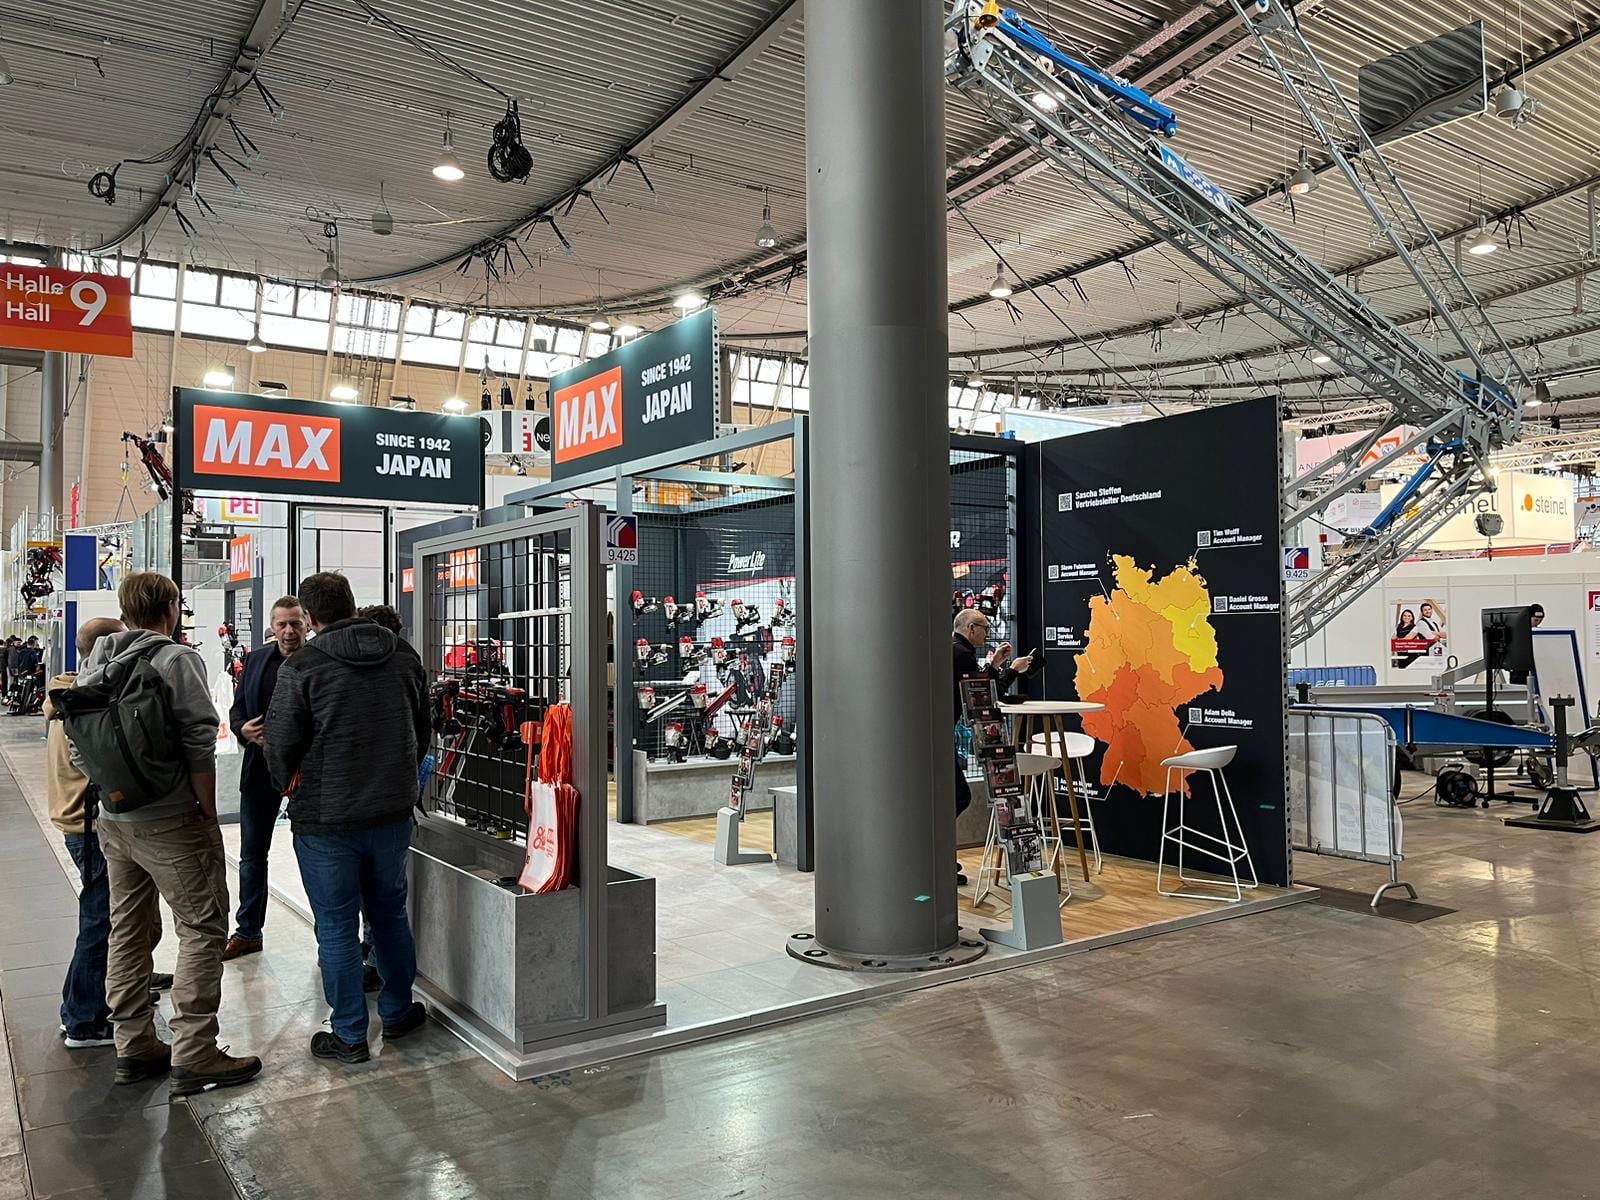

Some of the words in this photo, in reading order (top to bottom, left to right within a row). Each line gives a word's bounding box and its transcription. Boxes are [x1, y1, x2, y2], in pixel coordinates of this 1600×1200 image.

[6, 272, 64, 295] Halle
[70, 280, 107, 326] 9
[6, 301, 51, 322] Hall
[640, 365, 666, 387] SINCE
[668, 353, 692, 376] 1942
[641, 380, 693, 425] JAPAN
[558, 381, 619, 451] MAX
[202, 418, 333, 471] MAX
[375, 432, 416, 448] SINCE
[419, 437, 451, 451] 1942
[375, 453, 452, 479] JAPAN
[1075, 490, 1097, 499] Sascha
[1075, 497, 1119, 509] Vertriebsleiter
[1120, 489, 1161, 503] Deutschland
[1535, 494, 1568, 516] steinel
[1213, 536, 1236, 544] Account
[1237, 534, 1263, 543] Manager
[231, 541, 250, 575] MAX
[608, 549, 636, 562] 9.425
[1285, 570, 1309, 579] 9.425
[1229, 595, 1247, 603] Daniel
[1229, 603, 1253, 611] Account
[1253, 602, 1279, 611] Manager
[1204, 708, 1220, 716] Adam
[1227, 717, 1253, 726] Manager
